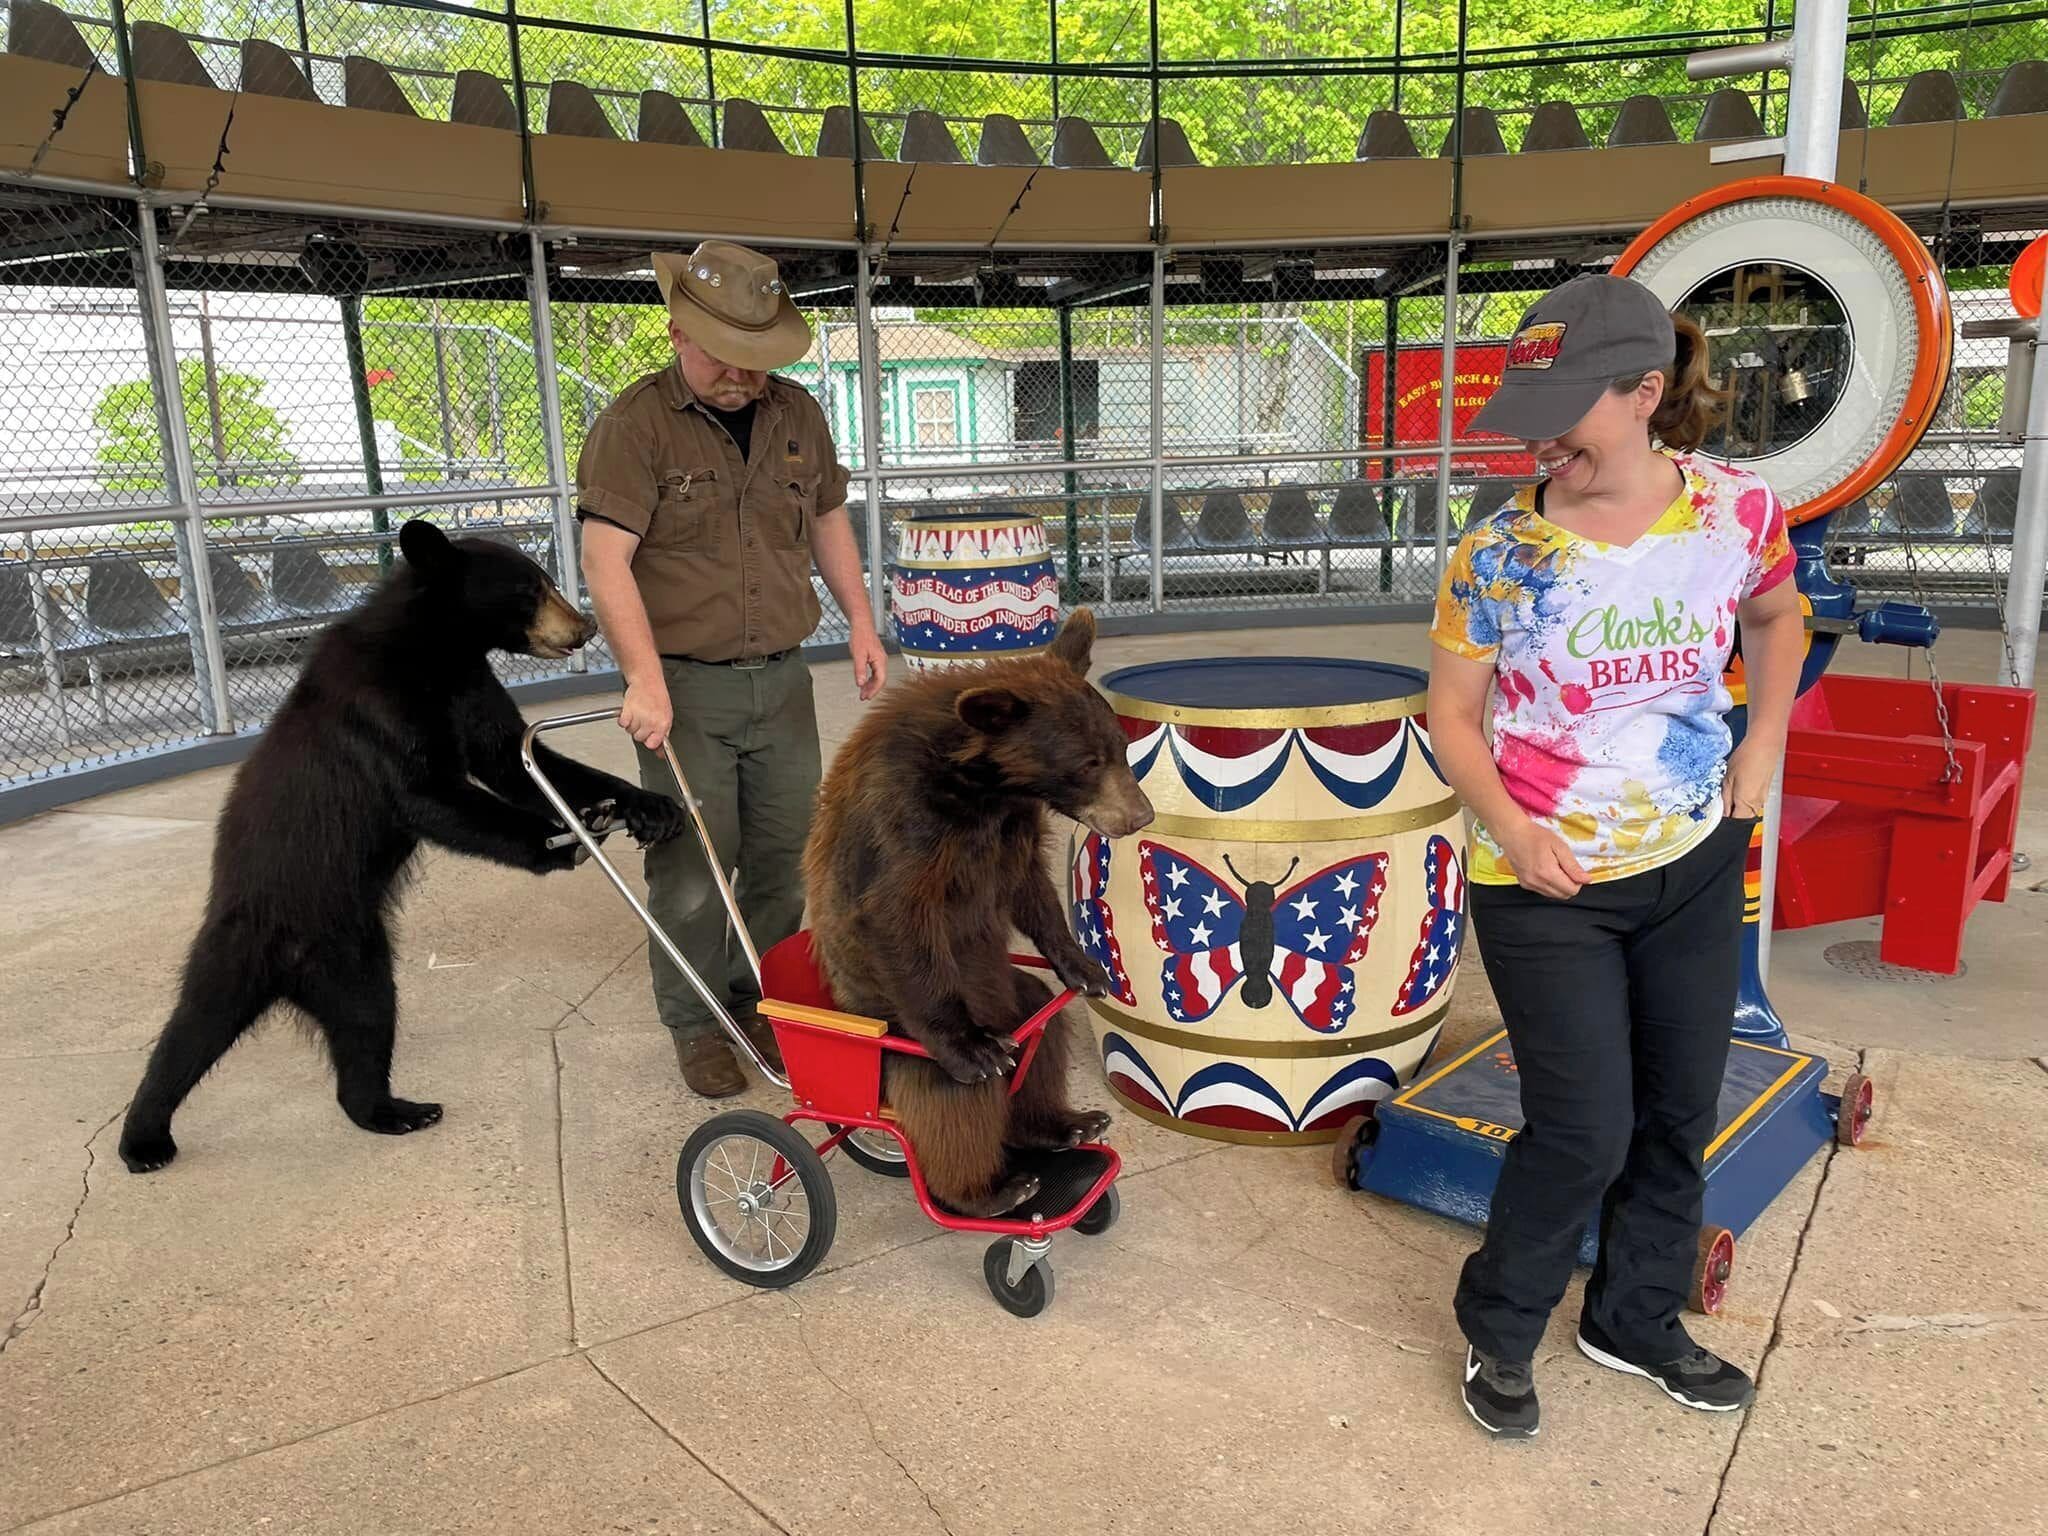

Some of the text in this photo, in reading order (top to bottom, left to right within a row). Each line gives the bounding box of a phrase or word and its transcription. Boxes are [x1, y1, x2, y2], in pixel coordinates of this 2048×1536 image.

[1398, 385, 1427, 408] EAST
[1430, 374, 1481, 391] BNCH
[1482, 375, 1491, 385] &
[906, 583, 915, 595] TO
[917, 578, 934, 592] THE
[935, 580, 963, 603] FLAG
[965, 588, 980, 603] OF
[980, 581, 1001, 598] THE
[1001, 580, 1032, 601] UNITED
[905, 608, 932, 626] NATION
[932, 610, 969, 634] UNDER
[970, 615, 994, 632] GOD
[995, 607, 1049, 631] INDIVISIBLE
[1567, 596, 1714, 659] Clark's
[1588, 647, 1701, 690] BEARS
